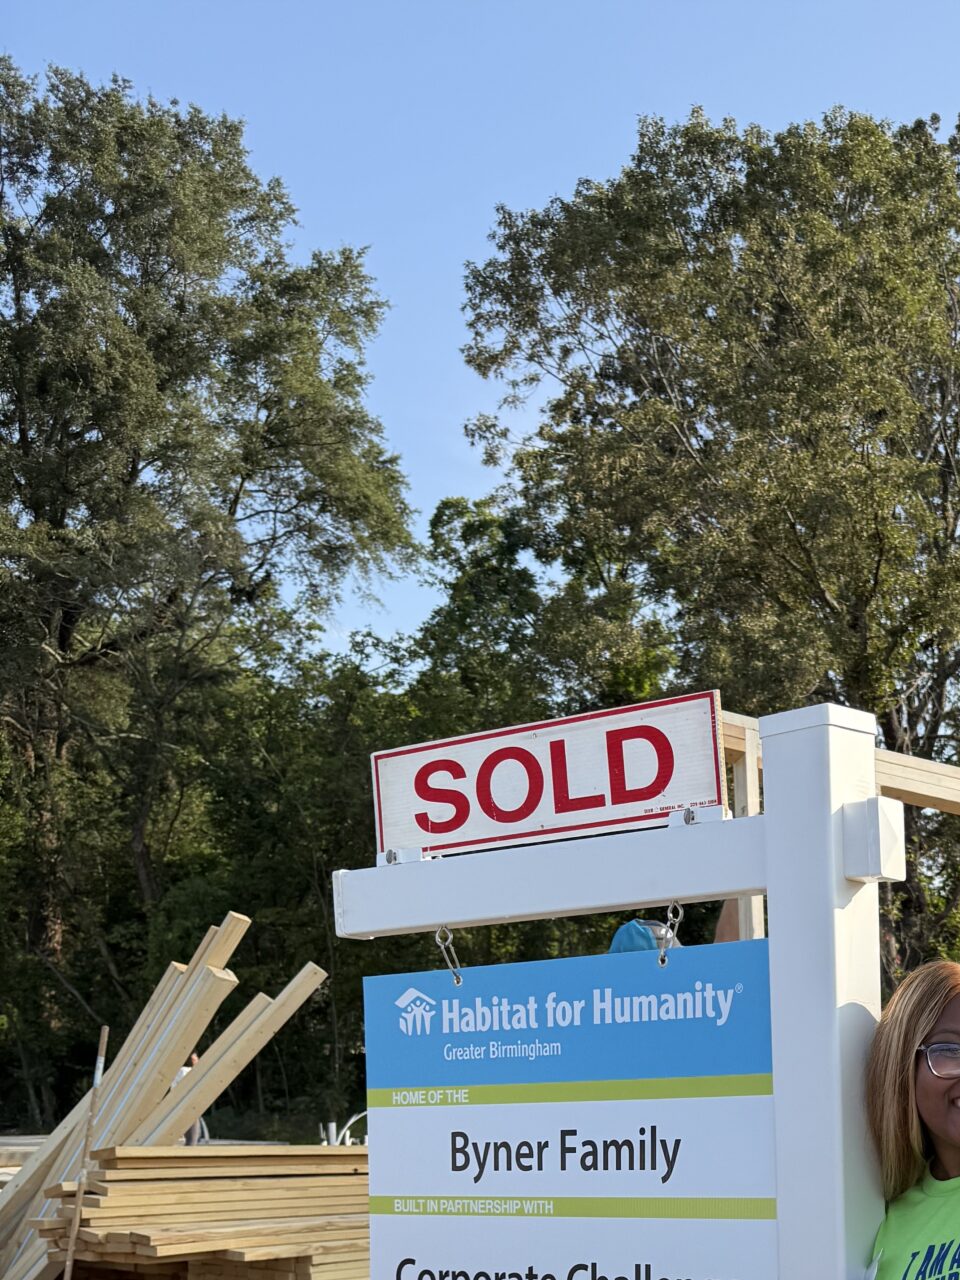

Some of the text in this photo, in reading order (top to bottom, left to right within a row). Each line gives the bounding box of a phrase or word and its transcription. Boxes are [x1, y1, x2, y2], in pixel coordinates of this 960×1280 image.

[413, 725, 675, 834] SOLD
[442, 992, 538, 1034] Habitat
[546, 991, 585, 1028] for
[444, 1039, 561, 1062] Greater Birmingham
[392, 1089, 469, 1105] HOME OF THE
[450, 1126, 682, 1184] Byner Family
[394, 1199, 554, 1214] BUILT IN PARTNERSHIP WITH
